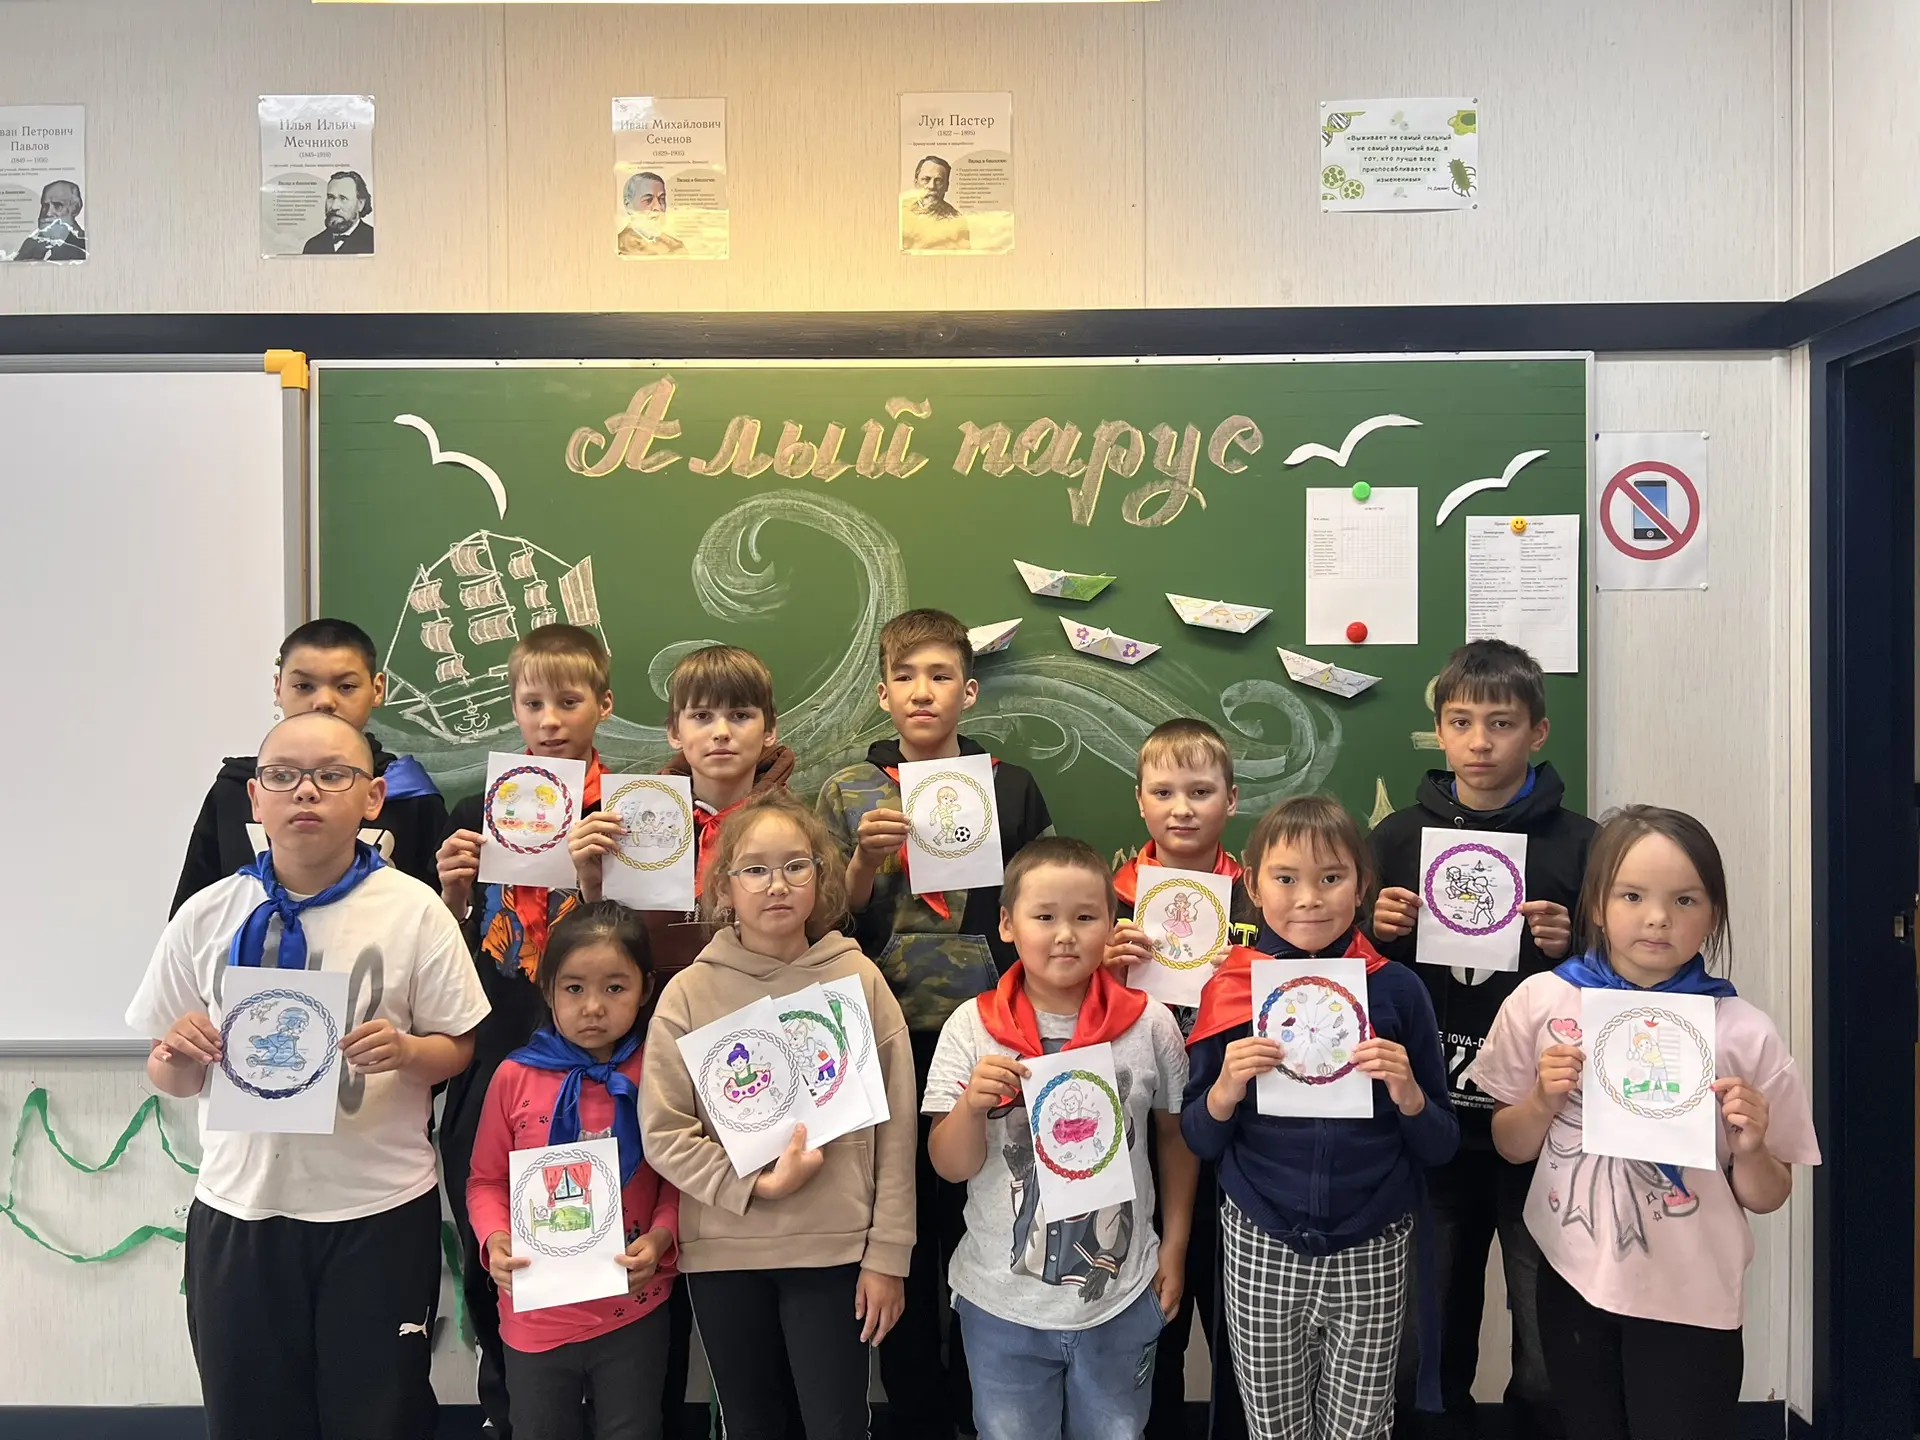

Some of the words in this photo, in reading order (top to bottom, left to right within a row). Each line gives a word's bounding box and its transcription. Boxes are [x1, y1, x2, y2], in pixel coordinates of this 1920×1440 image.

[316, 118, 357, 131] Ильич
[620, 119, 649, 130] Иван
[652, 118, 721, 130] Михайлович
[918, 115, 944, 129] Луи
[949, 114, 995, 128] Пастер
[0, 129, 18, 137] ван
[22, 125, 73, 139] Петрович
[11, 140, 50, 151] Павлов
[283, 135, 349, 149] Мечников
[646, 133, 692, 145] Сеченов
[565, 373, 931, 482] Алый
[951, 414, 1266, 527] парус
